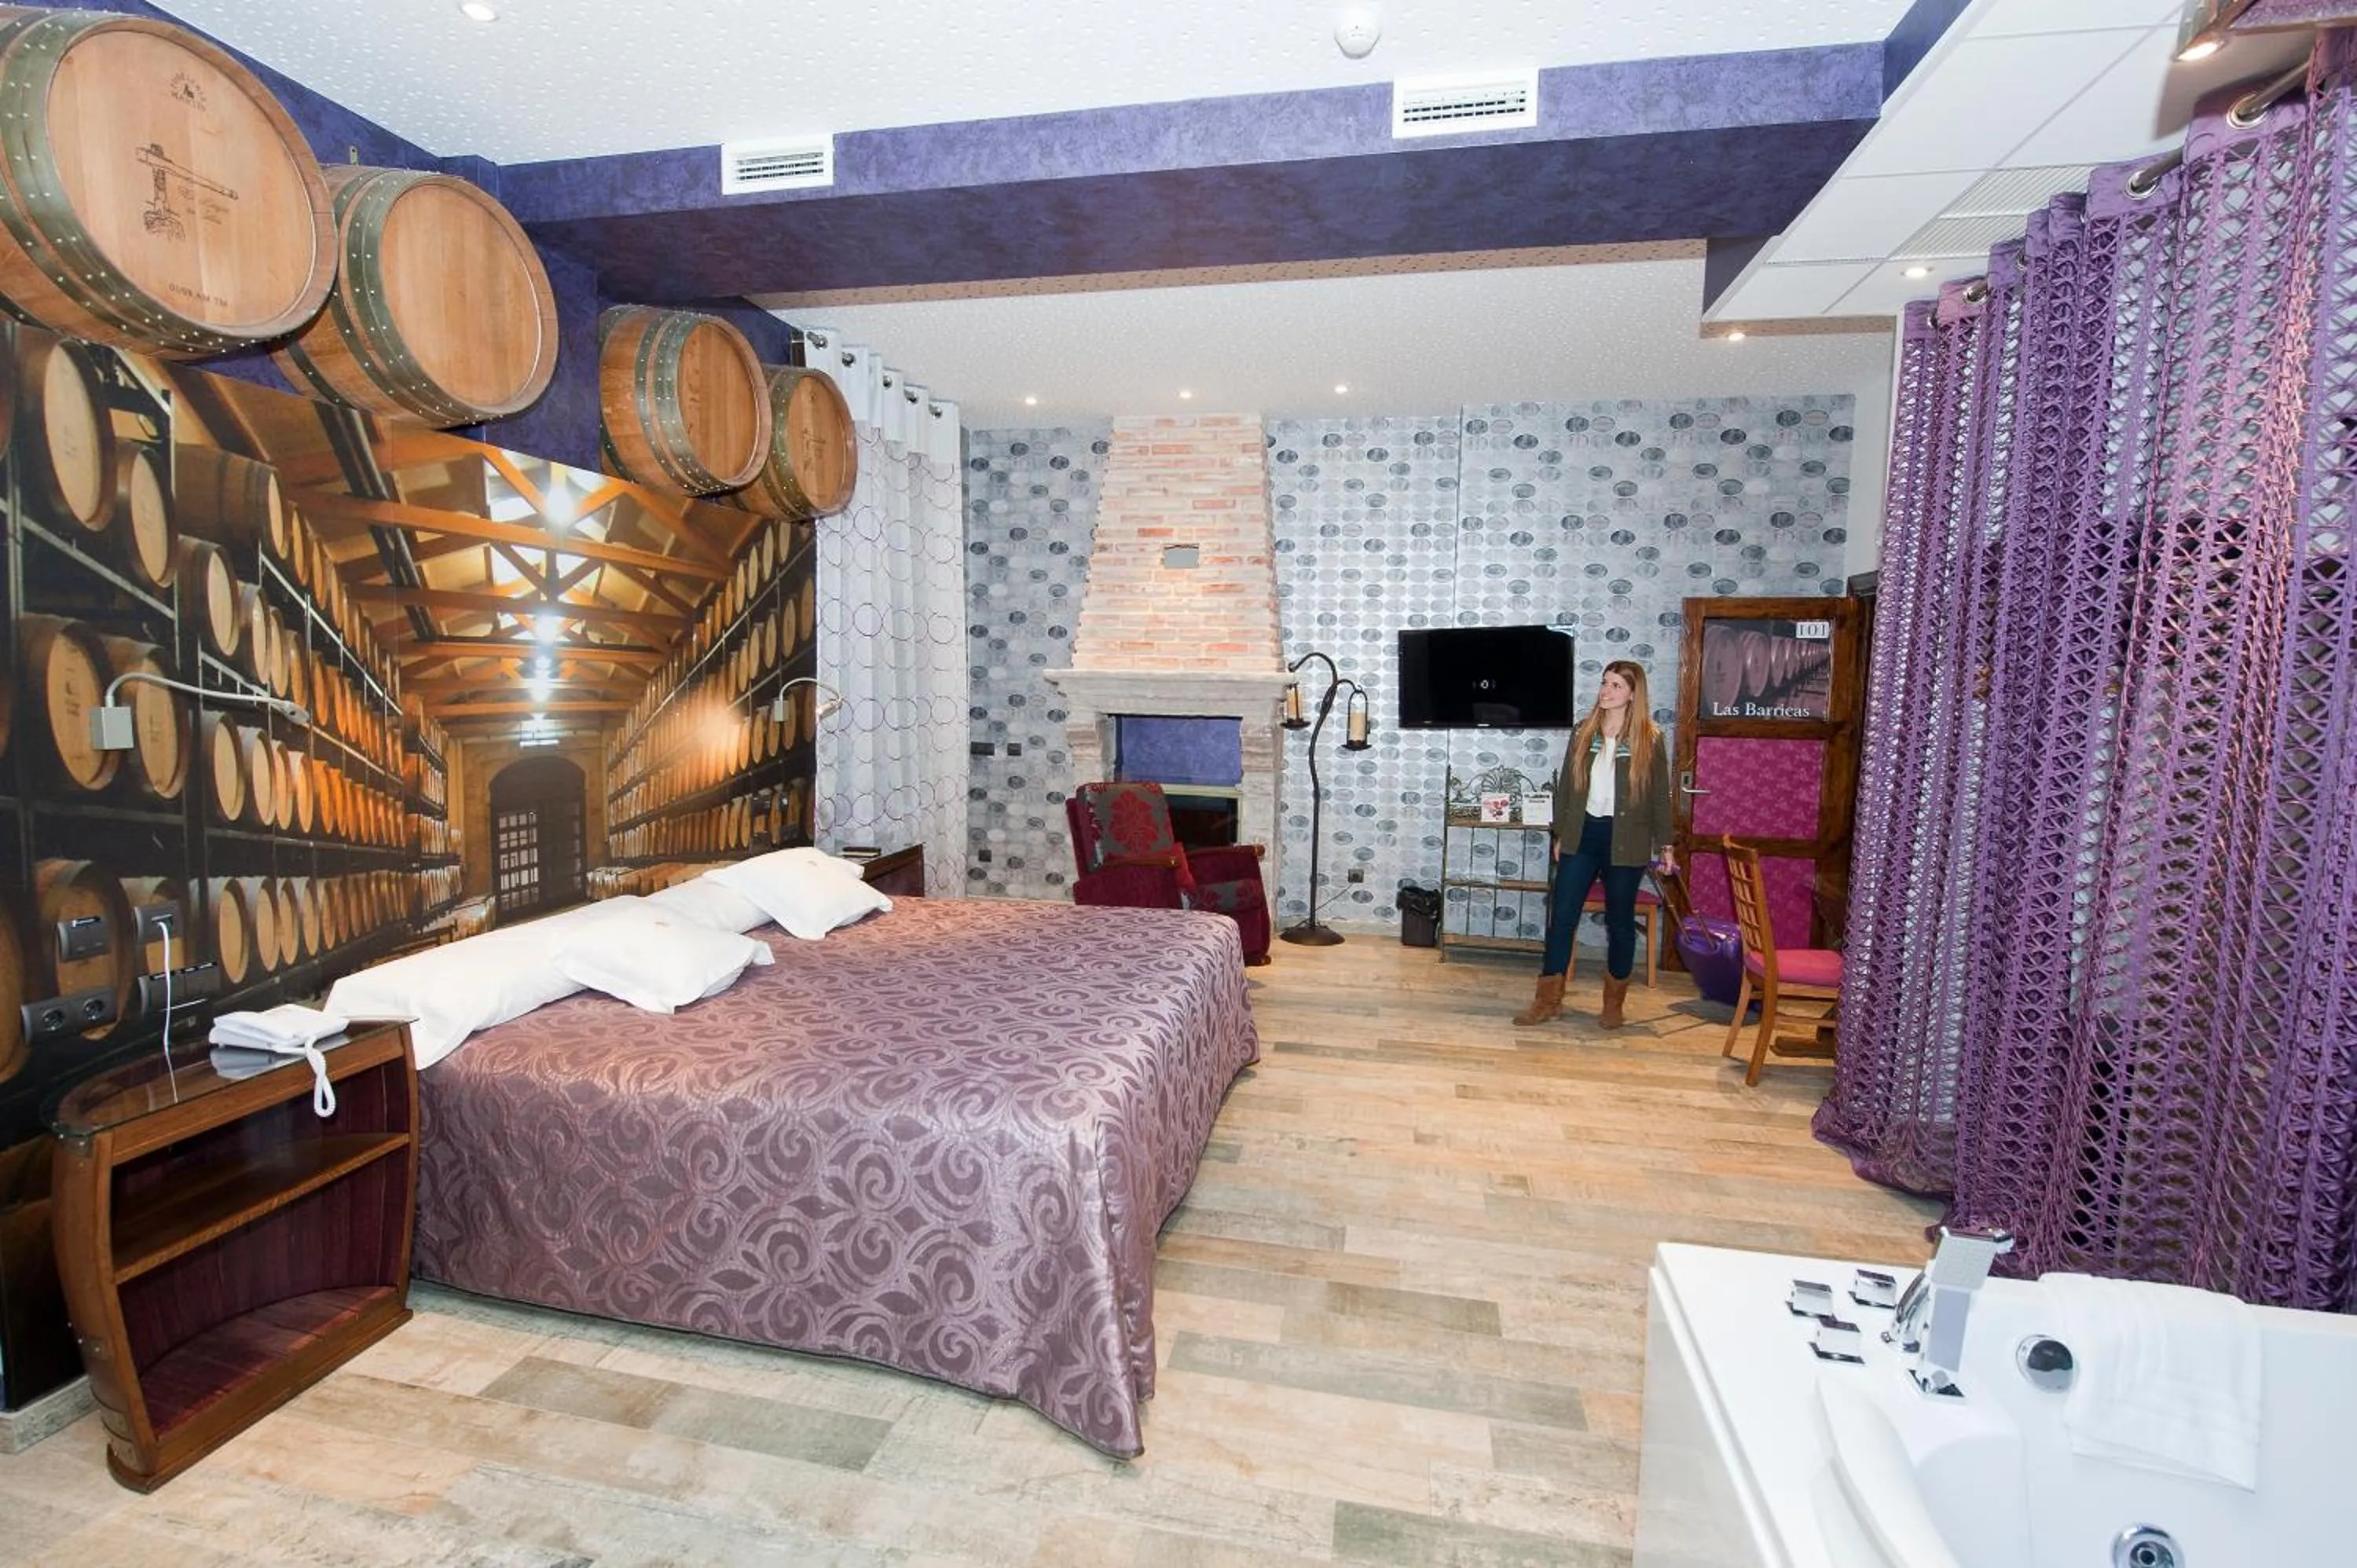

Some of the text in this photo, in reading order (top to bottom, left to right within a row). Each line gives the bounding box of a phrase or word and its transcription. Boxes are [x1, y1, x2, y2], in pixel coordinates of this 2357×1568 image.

[1799, 624, 1826, 636] 101
[1713, 701, 1810, 717] Las Barricas
